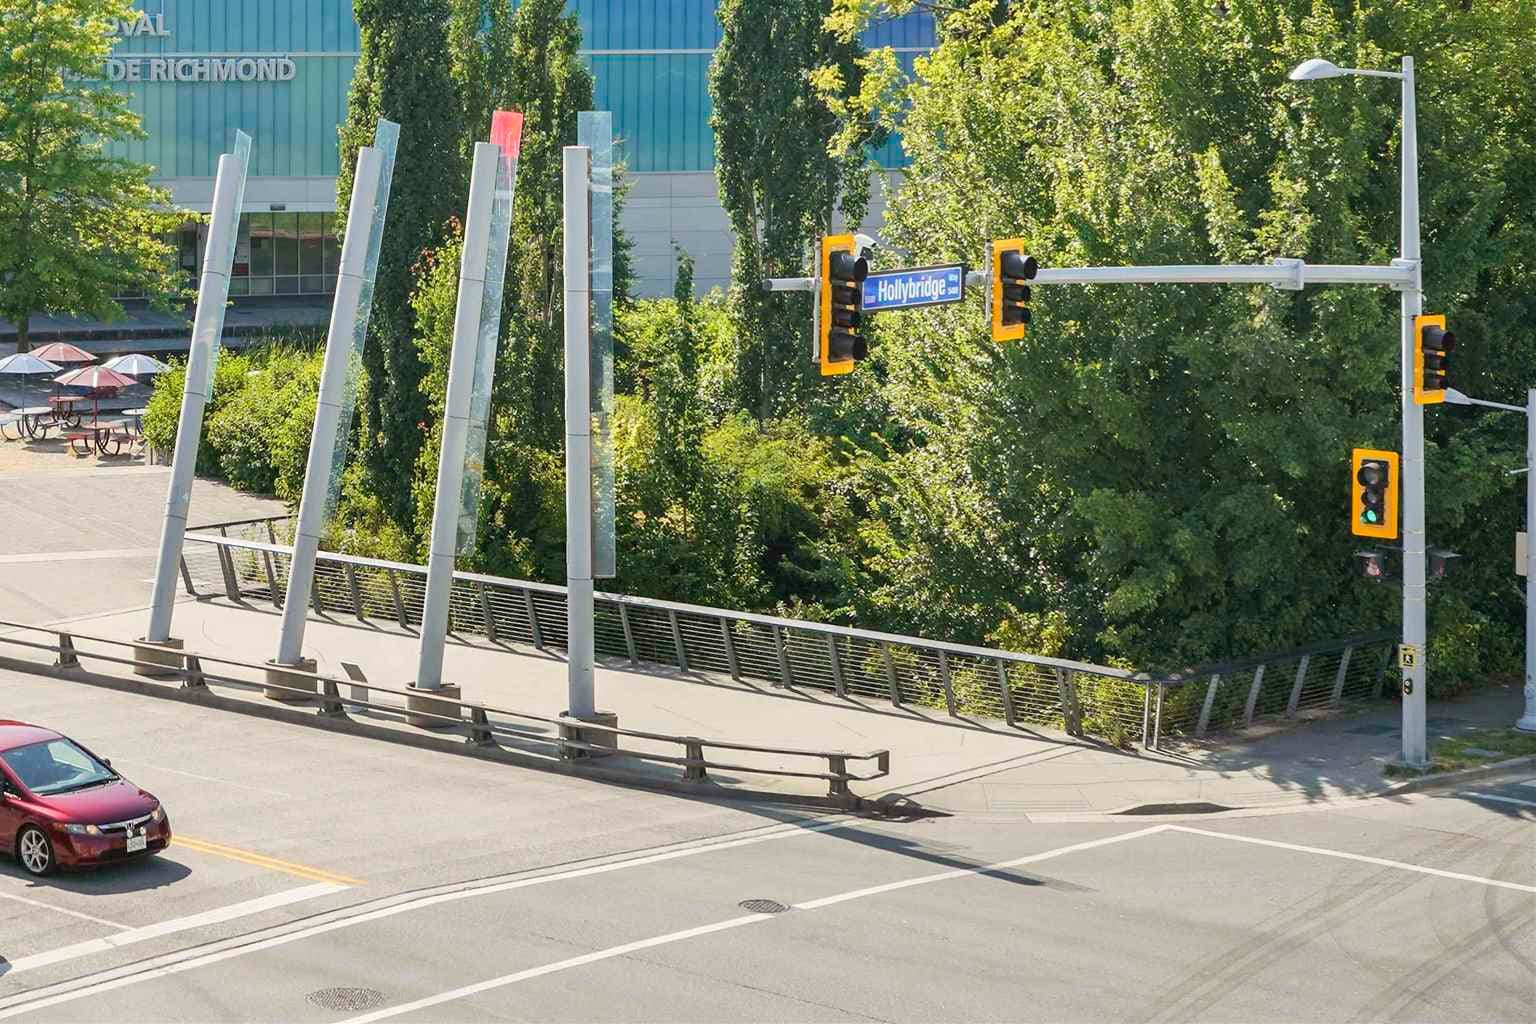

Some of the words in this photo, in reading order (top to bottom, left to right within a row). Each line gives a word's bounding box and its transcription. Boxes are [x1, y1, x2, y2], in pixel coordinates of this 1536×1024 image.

[107, 59, 141, 81] DE
[150, 58, 297, 82] RICHMOND
[878, 276, 946, 303] Hollybridge
